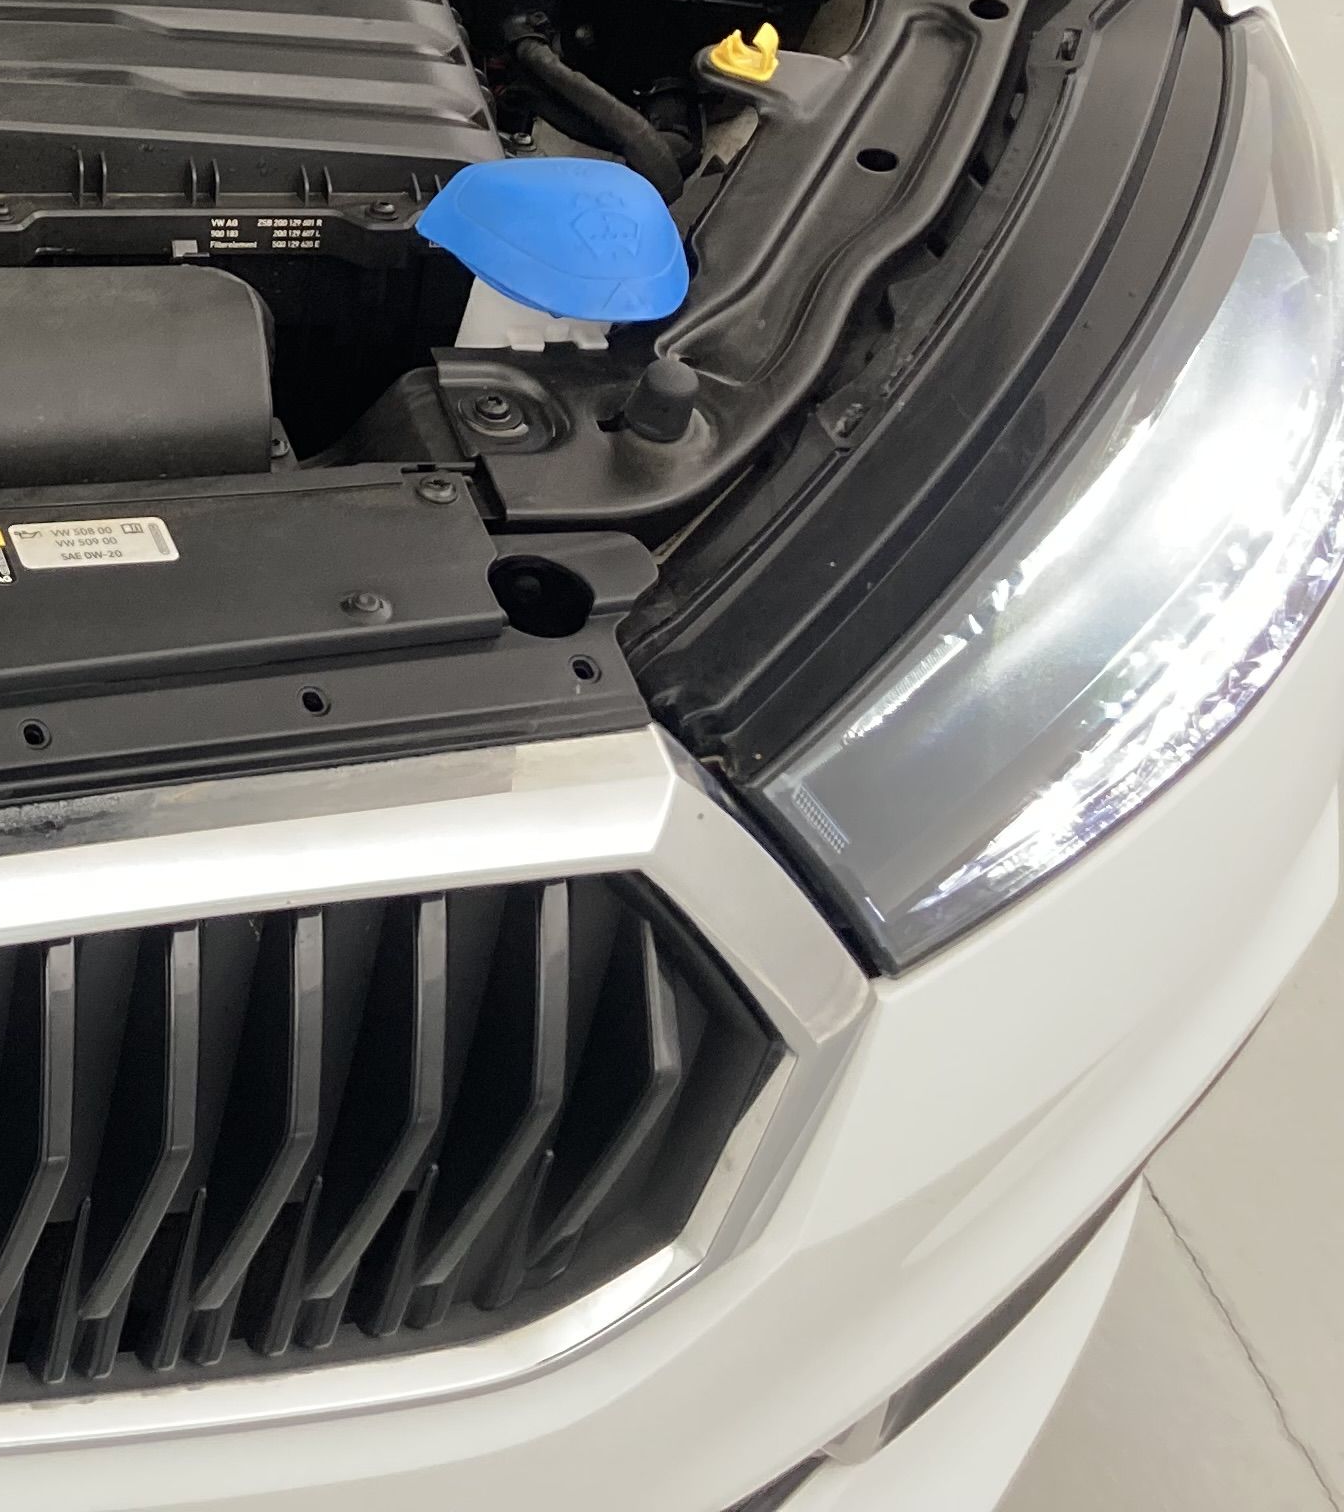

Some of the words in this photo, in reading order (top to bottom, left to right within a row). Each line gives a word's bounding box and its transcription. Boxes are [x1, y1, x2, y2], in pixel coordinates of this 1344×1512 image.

[211, 219, 225, 227] VW
[225, 219, 239, 227] AG
[50, 528, 70, 537] VW
[73, 527, 96, 536] 508
[97, 526, 113, 535] 00
[55, 539, 75, 547] VW
[78, 538, 99, 546] 509
[102, 536, 118, 545] 00
[60, 552, 82, 560] SAE
